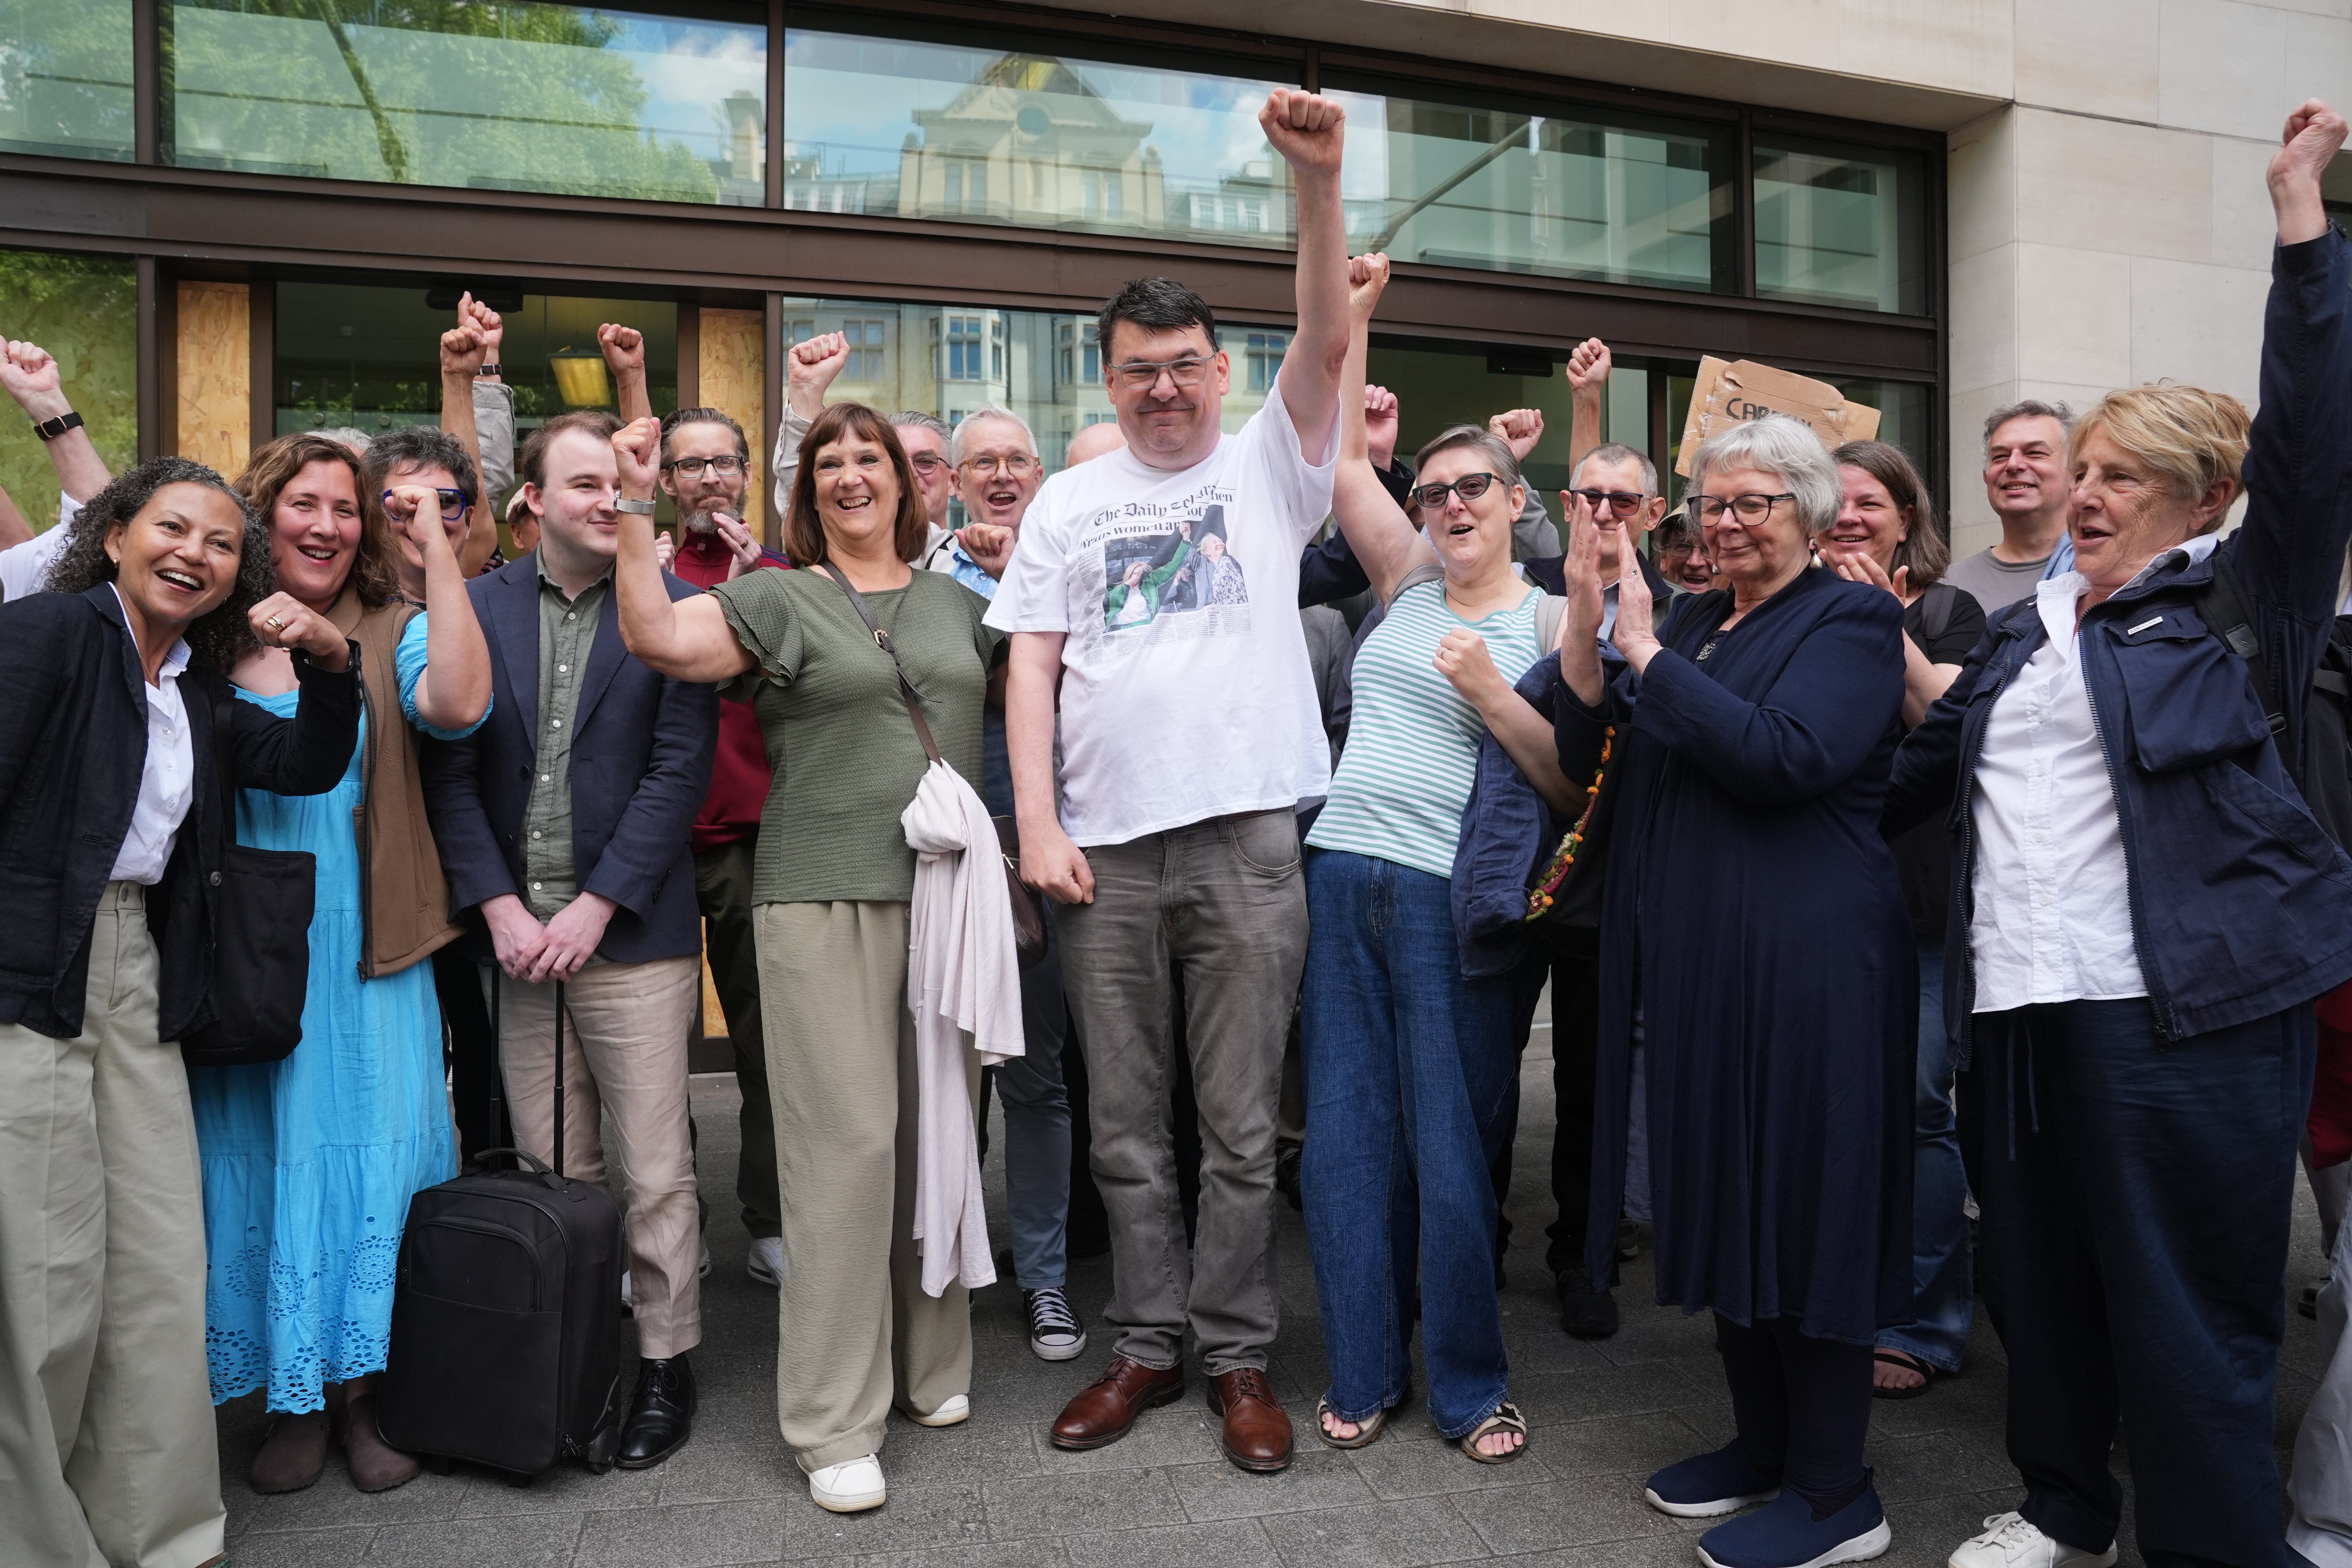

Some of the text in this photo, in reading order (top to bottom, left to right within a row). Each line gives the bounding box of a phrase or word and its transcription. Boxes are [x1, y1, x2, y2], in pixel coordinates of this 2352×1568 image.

[1094, 509, 1121, 526] The
[1123, 503, 1167, 518] Daily
[1081, 530, 1111, 549] Trans
[1114, 523, 1162, 534] women
[1166, 521, 1180, 530] ar
